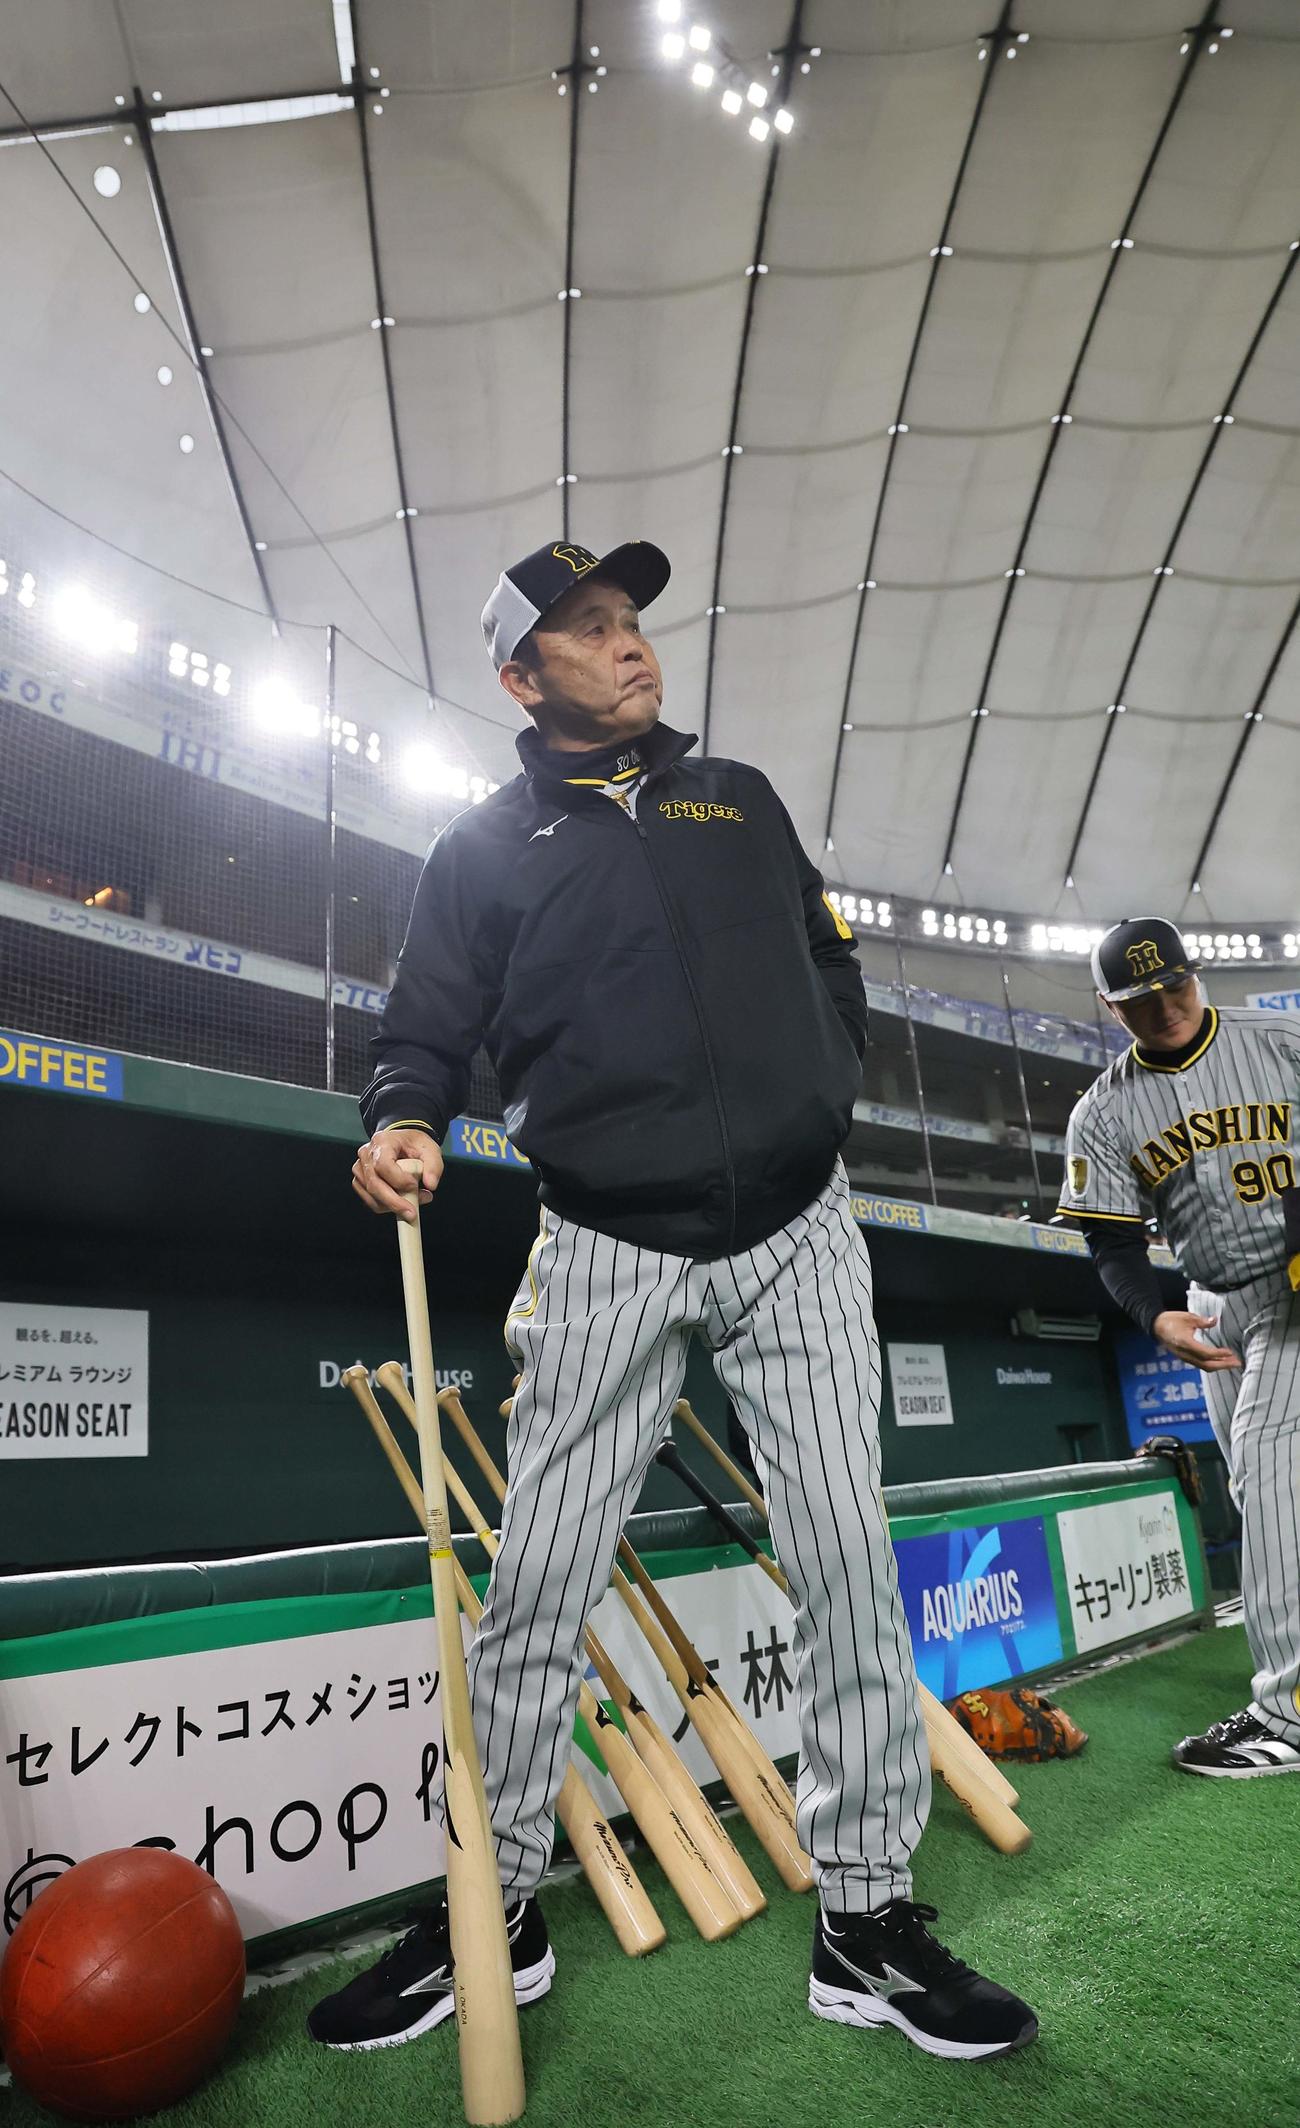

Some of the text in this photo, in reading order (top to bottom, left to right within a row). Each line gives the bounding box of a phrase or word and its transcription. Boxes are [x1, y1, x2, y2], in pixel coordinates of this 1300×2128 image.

[659, 800, 744, 822] Tigers
[462, 1123, 508, 1159] KEY
[1232, 1151, 1296, 1205] 90
[874, 1200, 922, 1228] COFFEE
[69, 1366, 132, 1383] ラウンジ
[0, 1402, 132, 1438] ASON SEAT
[1074, 1548, 1187, 1623] キョーリン製薬
[922, 1569, 1023, 1642] AQUARIUS
[131, 1781, 388, 1877] hop
[593, 1820, 622, 1865] Mizuno
[460, 1996, 468, 2025] OKADA
